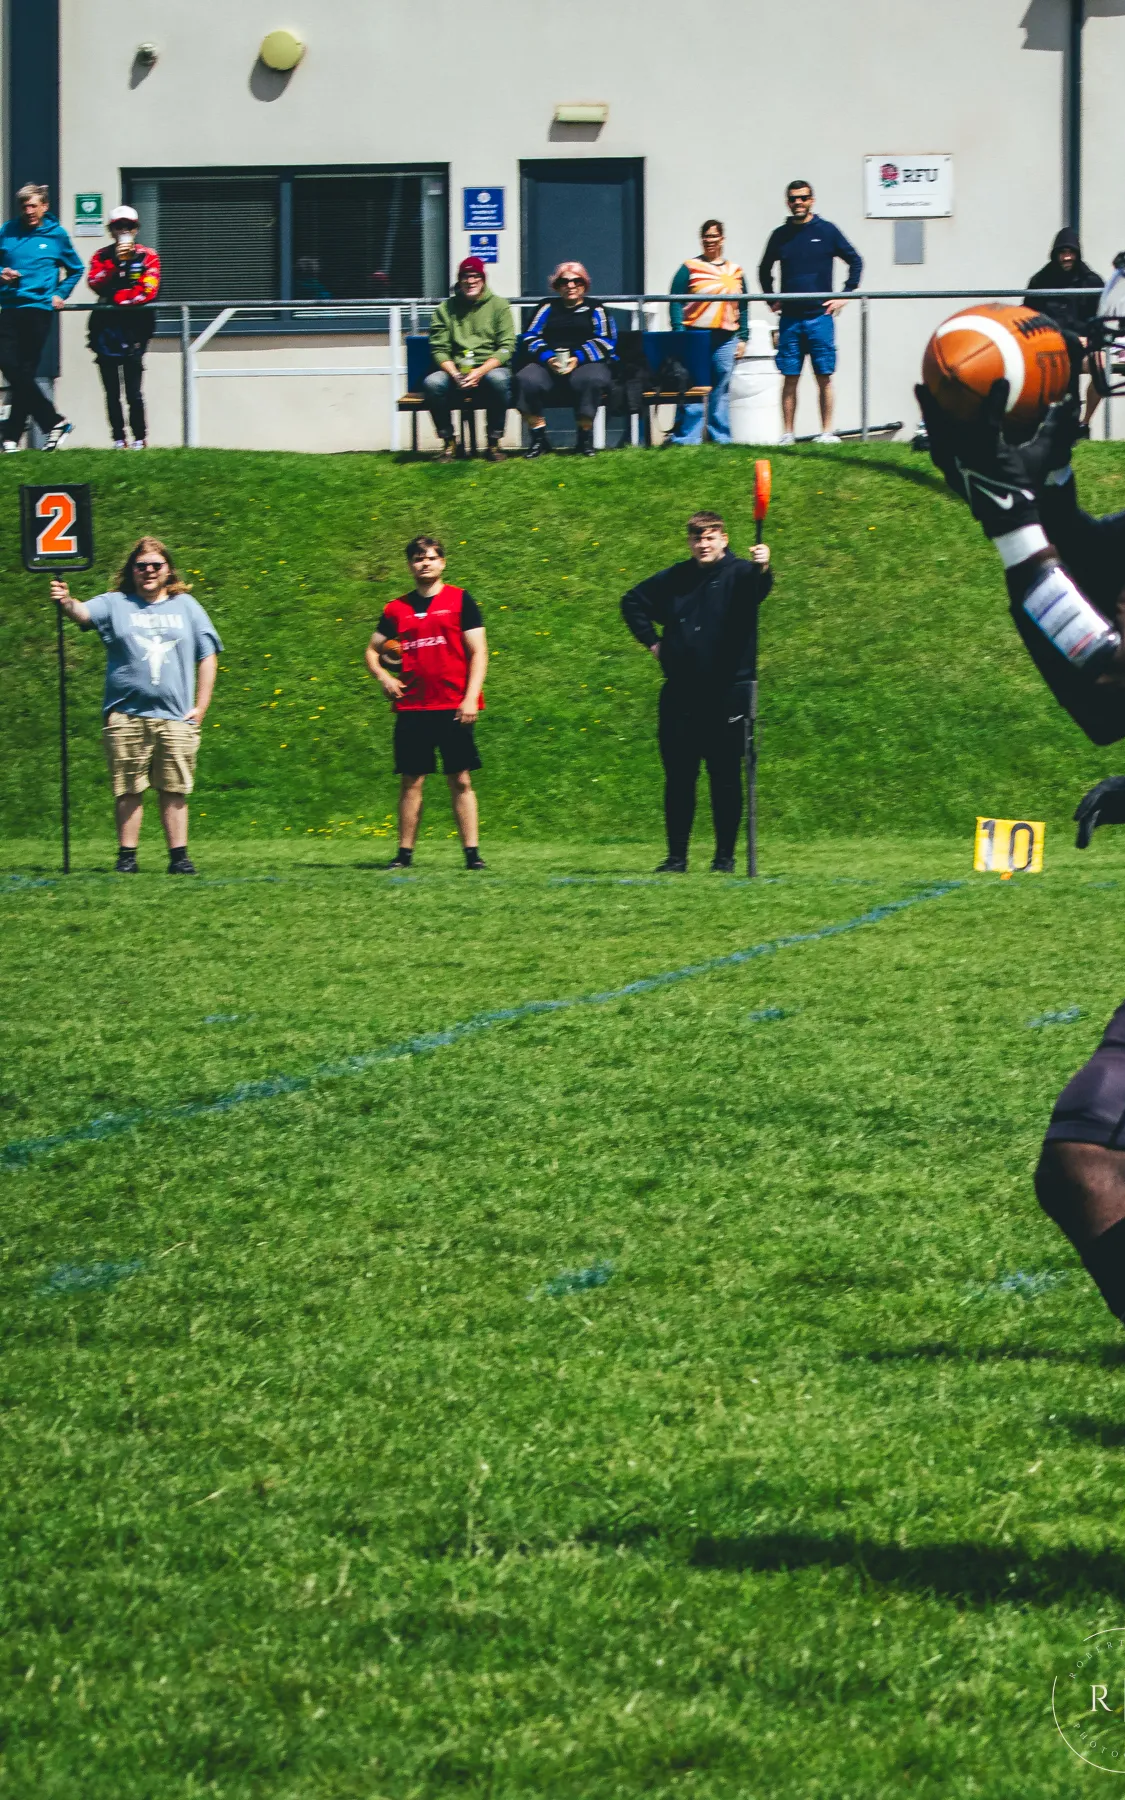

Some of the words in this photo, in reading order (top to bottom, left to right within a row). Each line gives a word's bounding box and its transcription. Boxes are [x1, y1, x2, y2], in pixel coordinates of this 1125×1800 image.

[902, 168, 938, 182] RFU
[35, 492, 78, 554] 2
[982, 820, 1035, 872] 10
